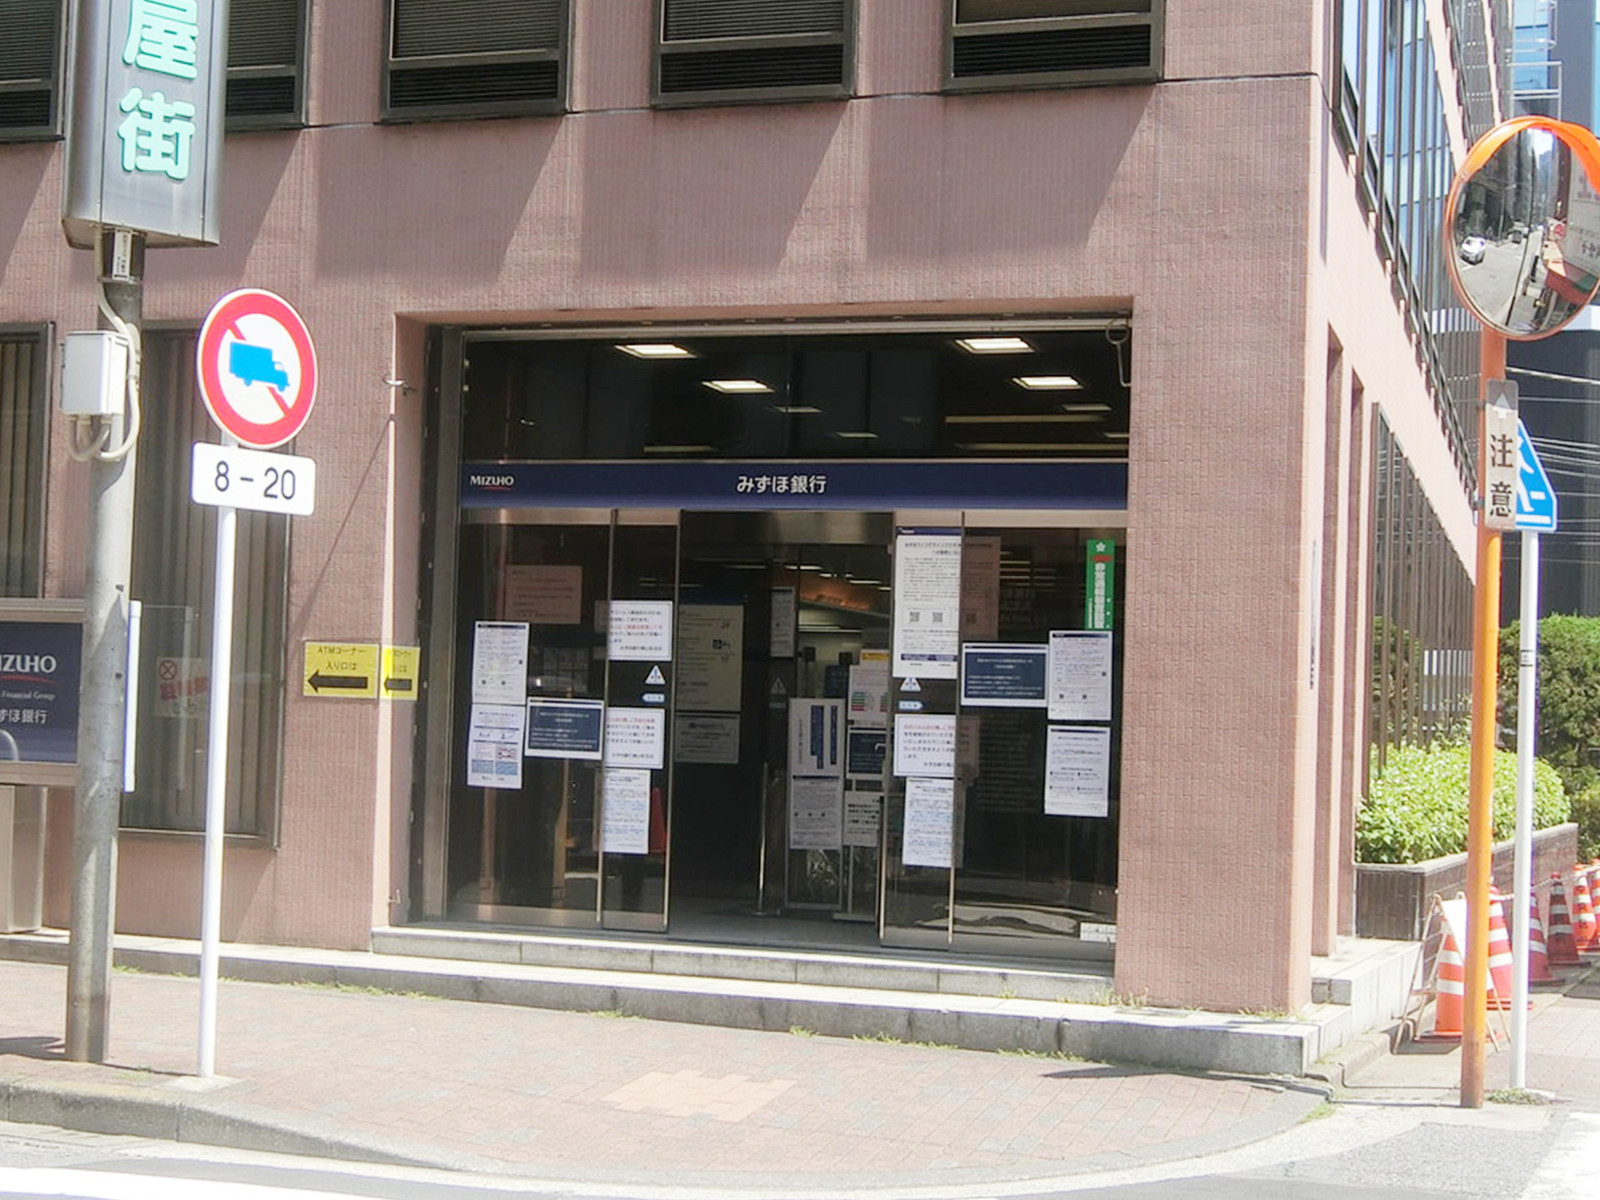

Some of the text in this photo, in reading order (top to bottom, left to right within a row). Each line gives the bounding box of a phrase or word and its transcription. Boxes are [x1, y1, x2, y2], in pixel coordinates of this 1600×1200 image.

[469, 475, 515, 487] MIZUHO
[1490, 434, 1514, 517] 注意
[736, 474, 827, 494] みずほ銀行
[317, 645, 367, 656] ATMコーナー
[325, 660, 358, 671] 入り口は
